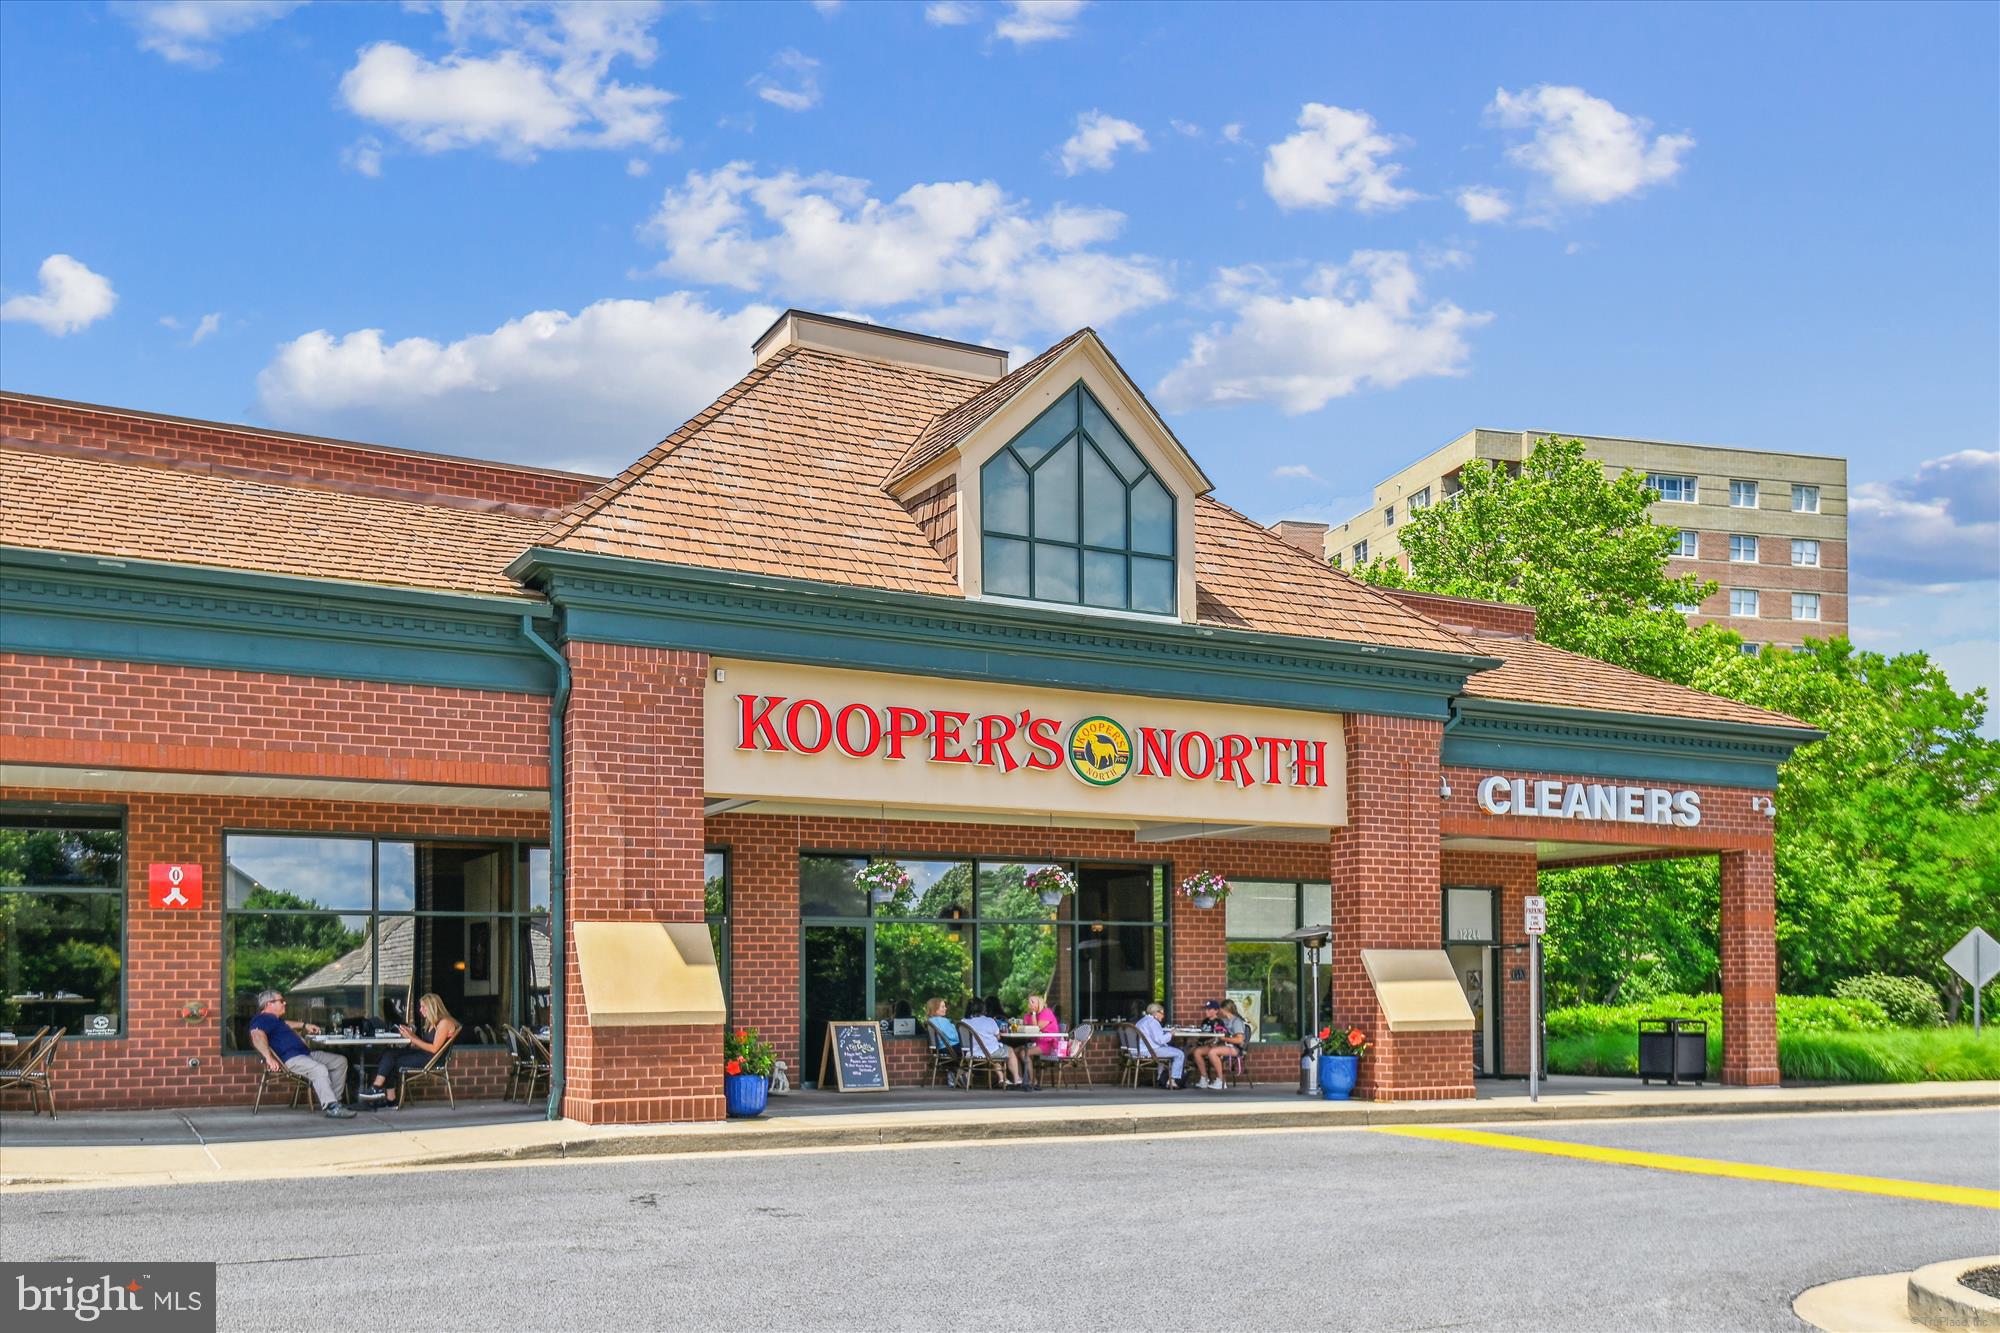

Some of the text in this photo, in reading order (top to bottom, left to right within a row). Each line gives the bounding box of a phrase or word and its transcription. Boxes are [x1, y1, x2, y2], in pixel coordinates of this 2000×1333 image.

[735, 694, 1328, 789] KOOPER'S NORTH
[1087, 767, 1117, 781] NORTH
[1477, 776, 1701, 828] CLEANERS
[1531, 899, 1539, 907] NO
